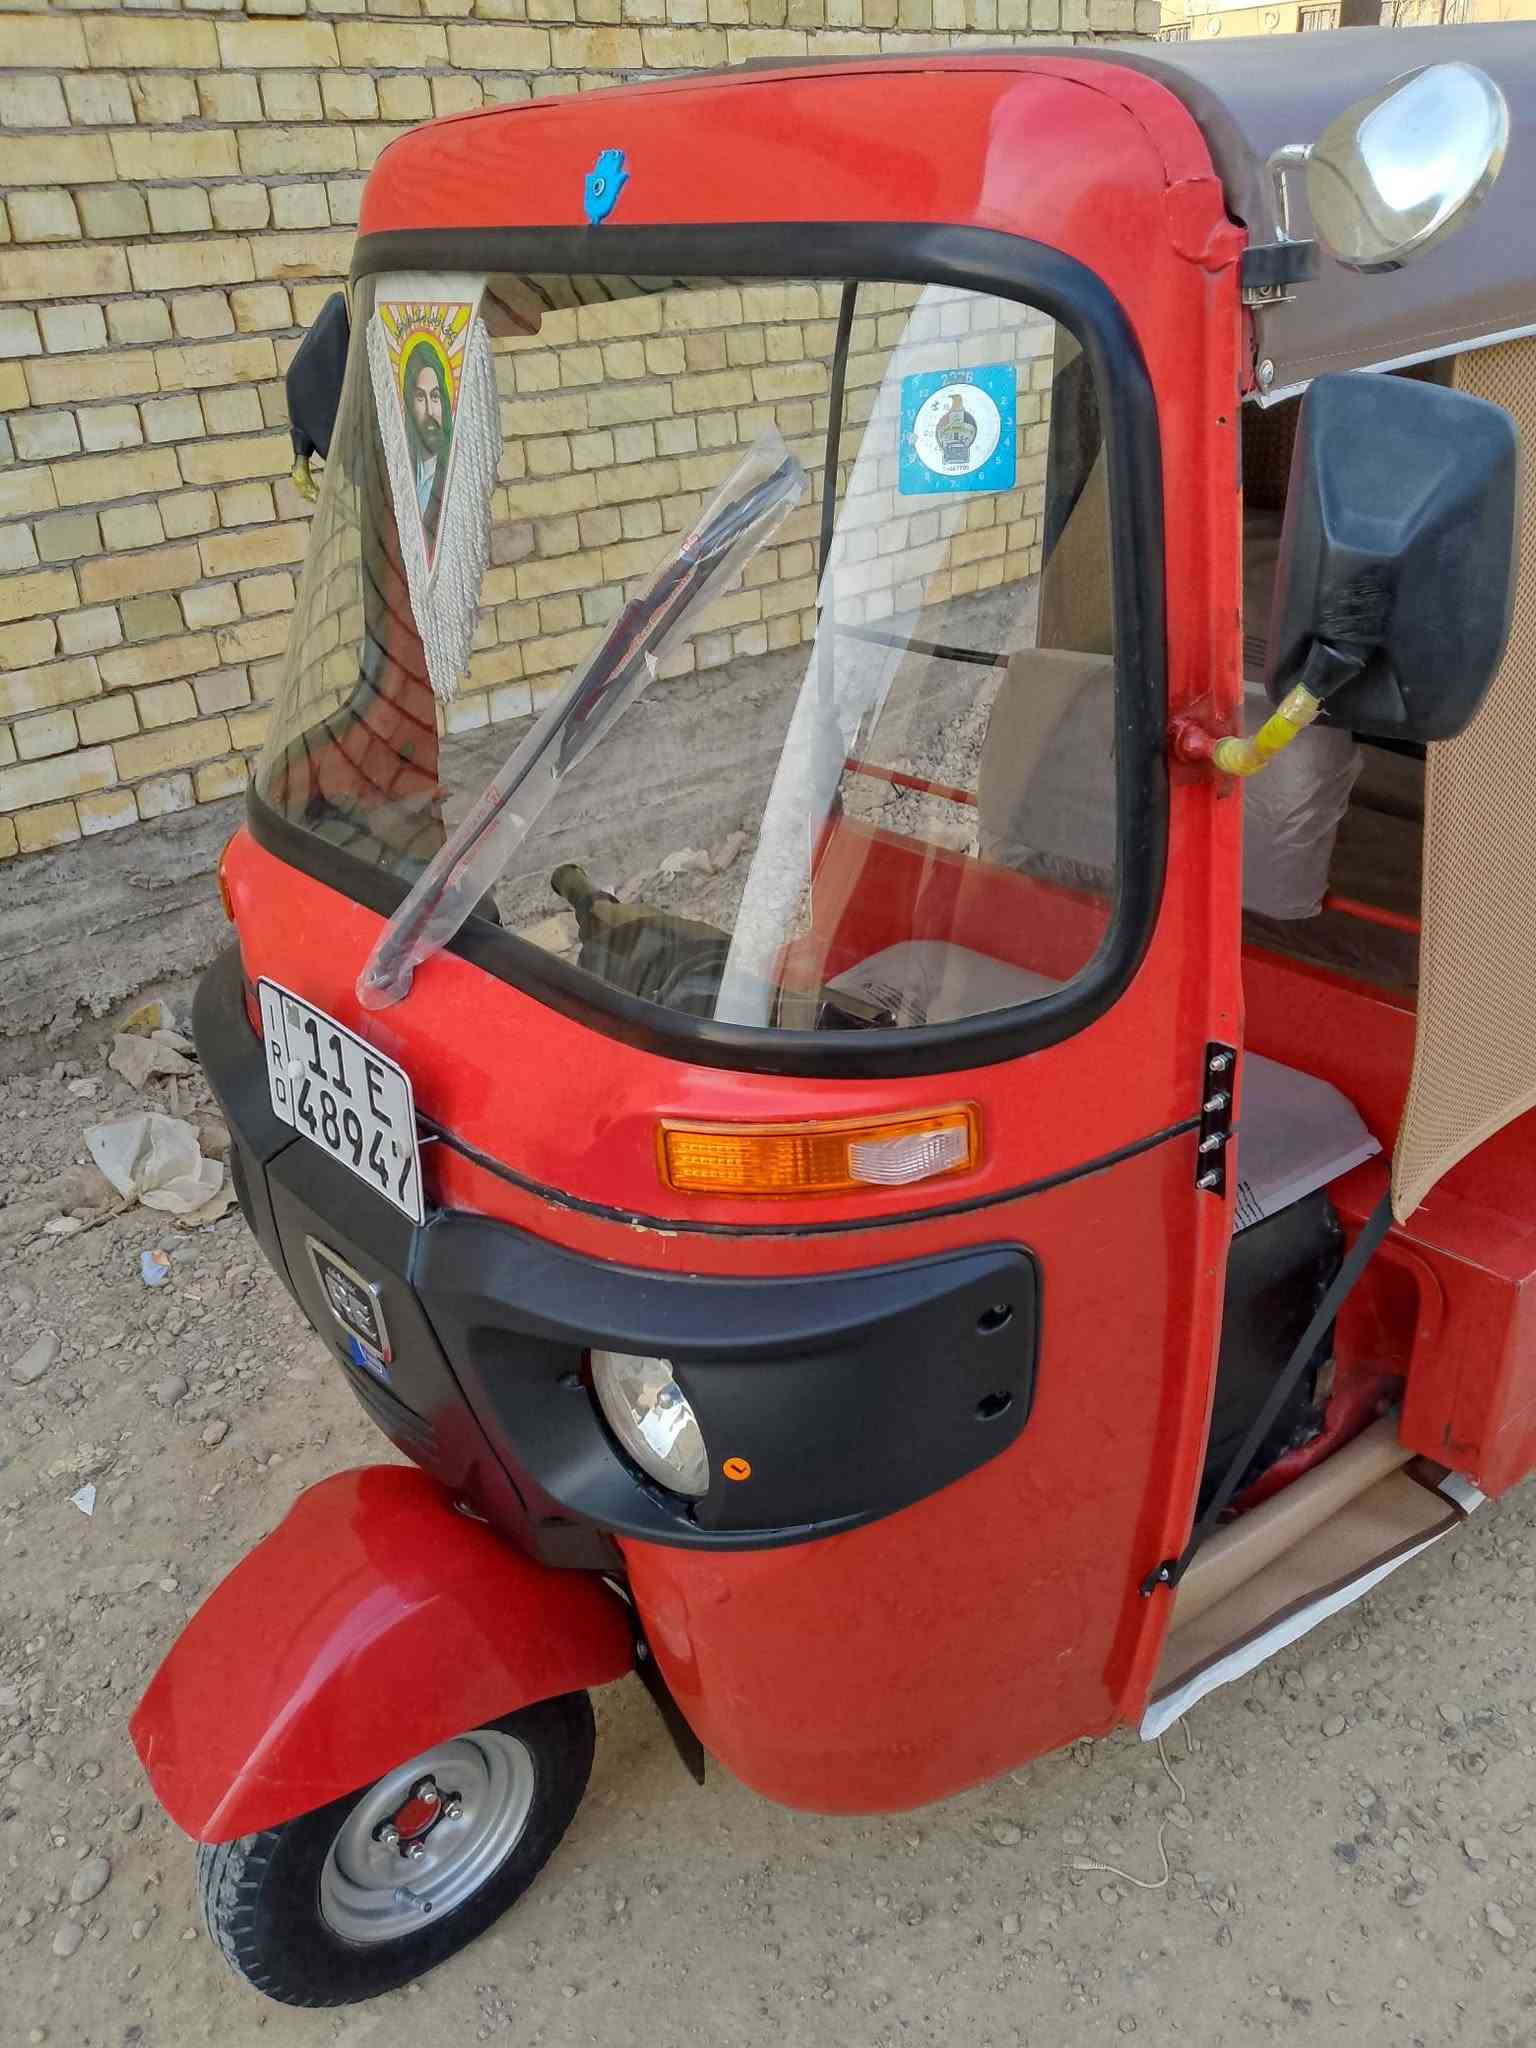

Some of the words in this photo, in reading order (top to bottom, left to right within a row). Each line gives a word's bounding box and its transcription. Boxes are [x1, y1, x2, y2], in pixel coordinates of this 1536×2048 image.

[304, 1018, 352, 1099] 11
[363, 1056, 393, 1129] E
[297, 1078, 413, 1203] 48947
